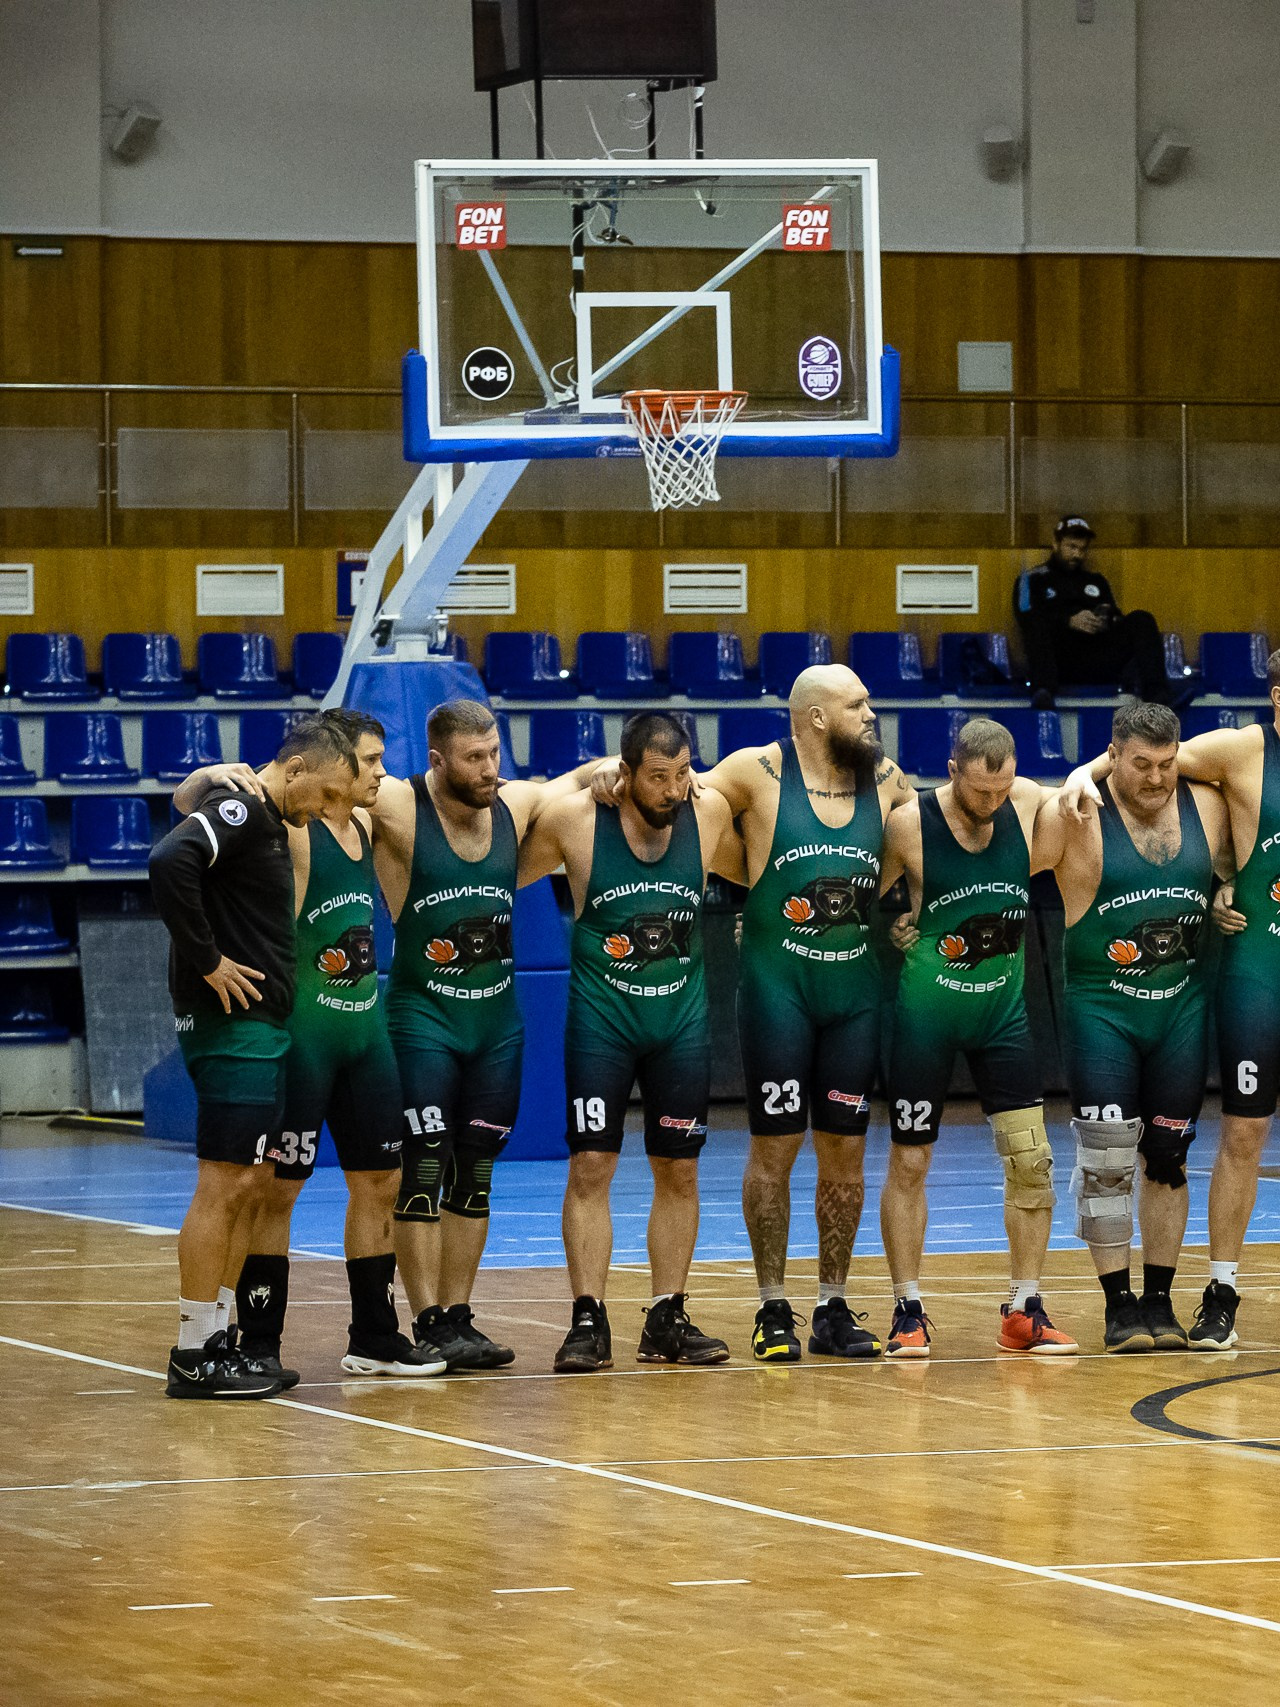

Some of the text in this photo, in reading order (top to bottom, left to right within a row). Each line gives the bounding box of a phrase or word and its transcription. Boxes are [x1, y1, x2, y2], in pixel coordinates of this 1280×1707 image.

[458, 207, 503, 226] FON
[785, 209, 829, 227] FON
[459, 225, 504, 245] BET
[785, 227, 829, 246] BET
[469, 366, 508, 382] РФБ
[591, 881, 701, 910] РОЩИНСКИЕ
[928, 882, 1029, 913] РОЩИНСКИЕ
[1097, 887, 1208, 916] РОЩИНСКИЕ
[782, 938, 867, 961] МЕДВЕДИ
[427, 975, 511, 1000] МЕДВЕДИ
[604, 973, 687, 997] МЕДВЕДИ
[1109, 975, 1190, 1000] МЕДВЕДИ
[1237, 1060, 1258, 1095] 6
[761, 1079, 801, 1115] 23
[403, 1105, 447, 1135] 18
[573, 1096, 606, 1133] 19
[896, 1099, 932, 1131] 32
[281, 1130, 317, 1166] 35
